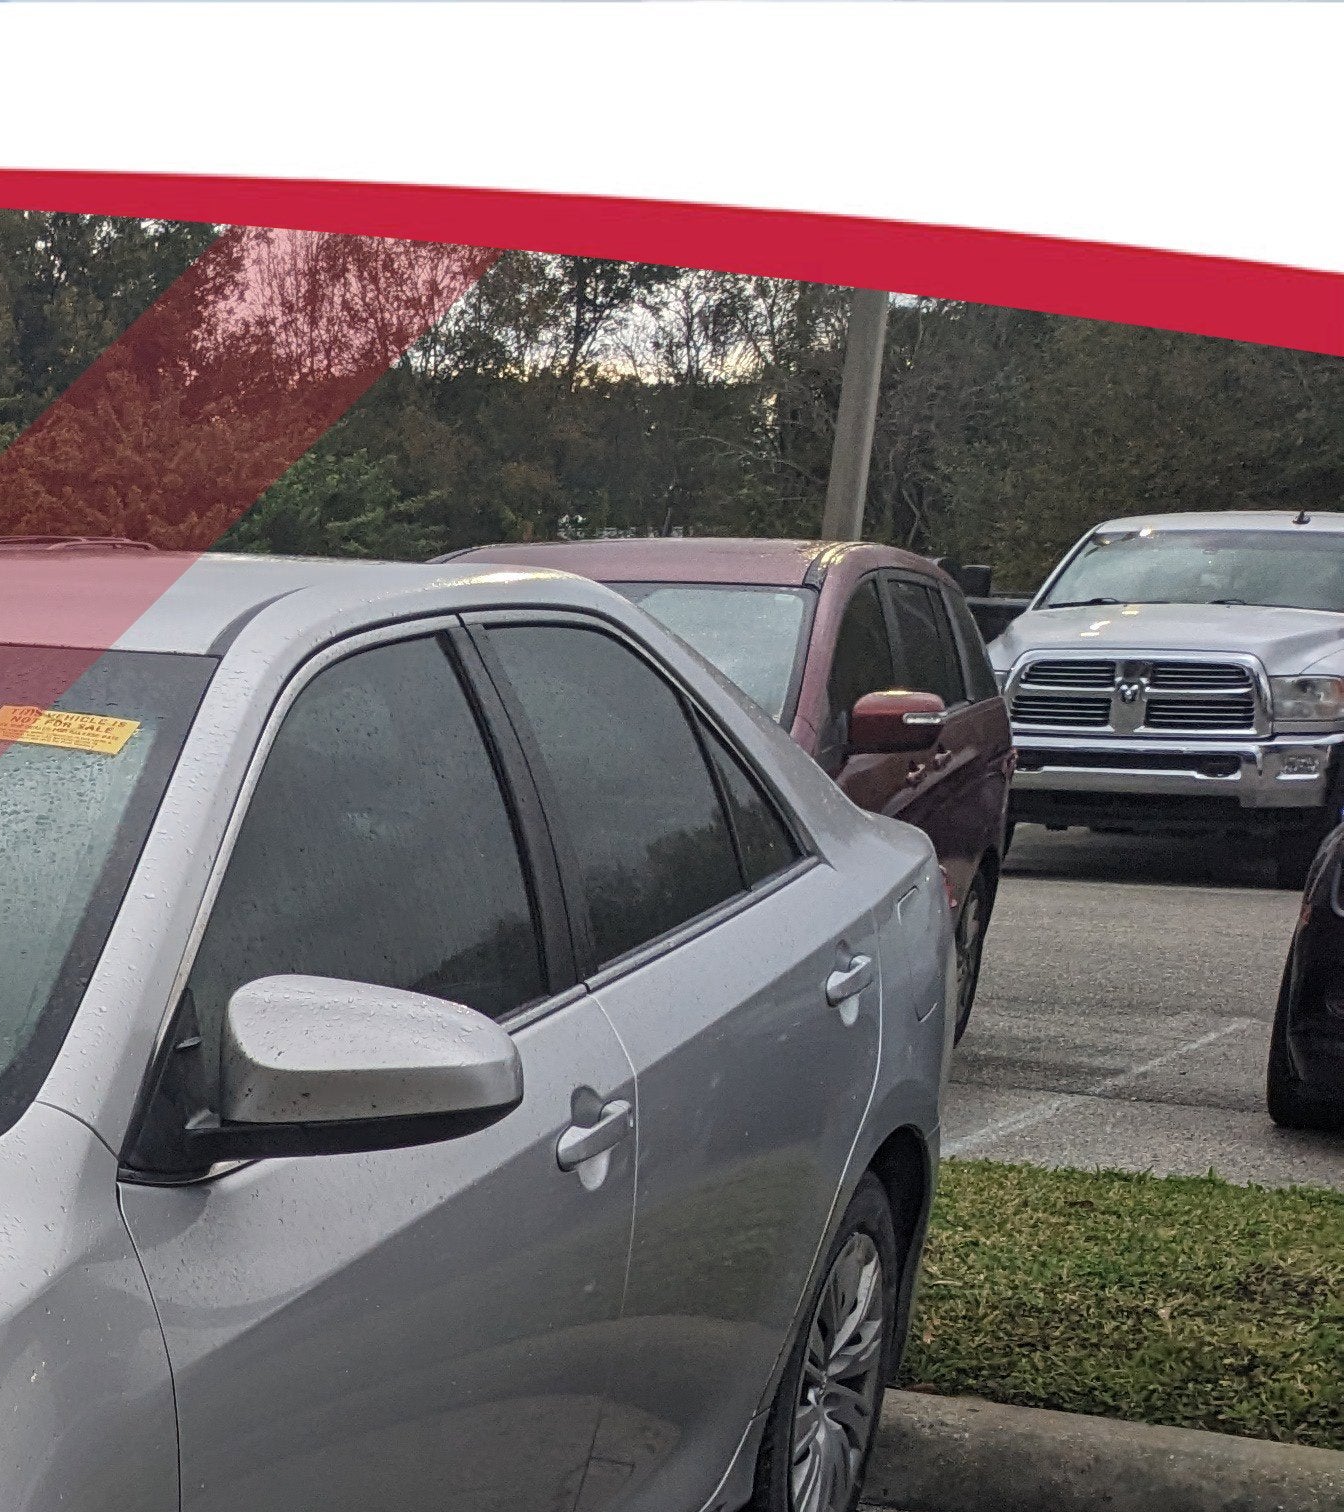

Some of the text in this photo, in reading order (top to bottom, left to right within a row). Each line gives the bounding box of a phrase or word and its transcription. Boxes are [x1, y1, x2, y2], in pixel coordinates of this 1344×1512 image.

[10, 715, 40, 725] NOT
[44, 719, 72, 728] FOR
[78, 722, 115, 734] SALE
[46, 712, 109, 726] VEHICLE
[112, 720, 128, 729] IS
